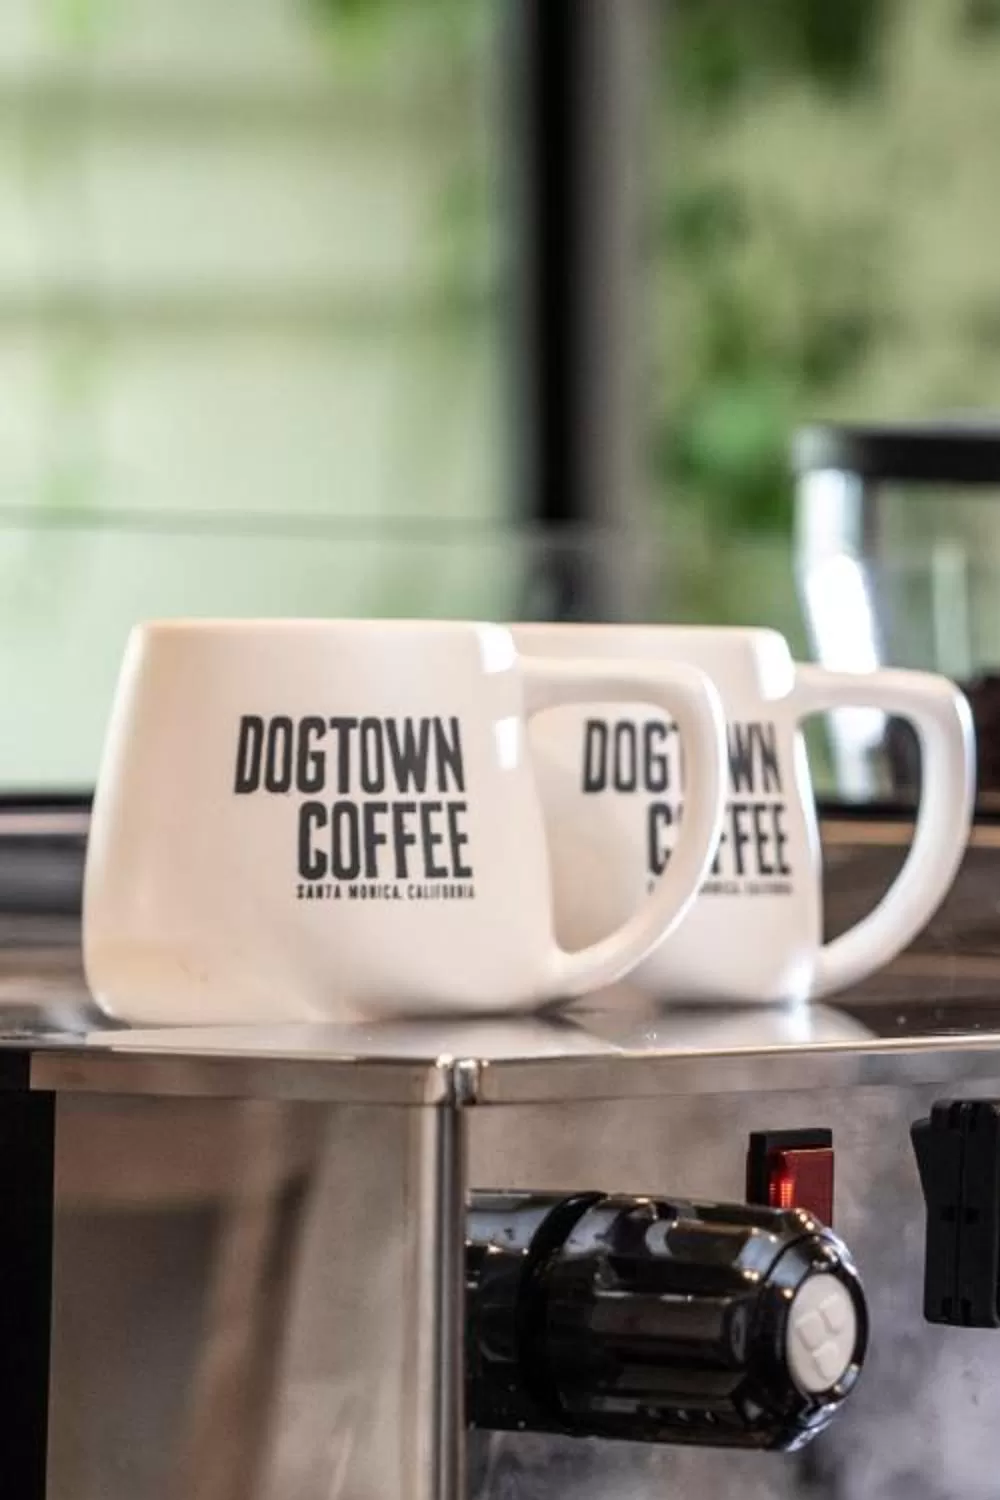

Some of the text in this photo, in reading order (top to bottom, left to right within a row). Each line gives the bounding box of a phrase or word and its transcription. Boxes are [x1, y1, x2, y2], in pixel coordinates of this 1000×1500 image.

[234, 715, 466, 794] DOGTOWN
[582, 718, 783, 794] DOGWN
[297, 801, 473, 881] COFFEE
[646, 801, 793, 877] CFEE
[297, 884, 342, 900] SANTA
[407, 884, 476, 900] CALIFORNIA
